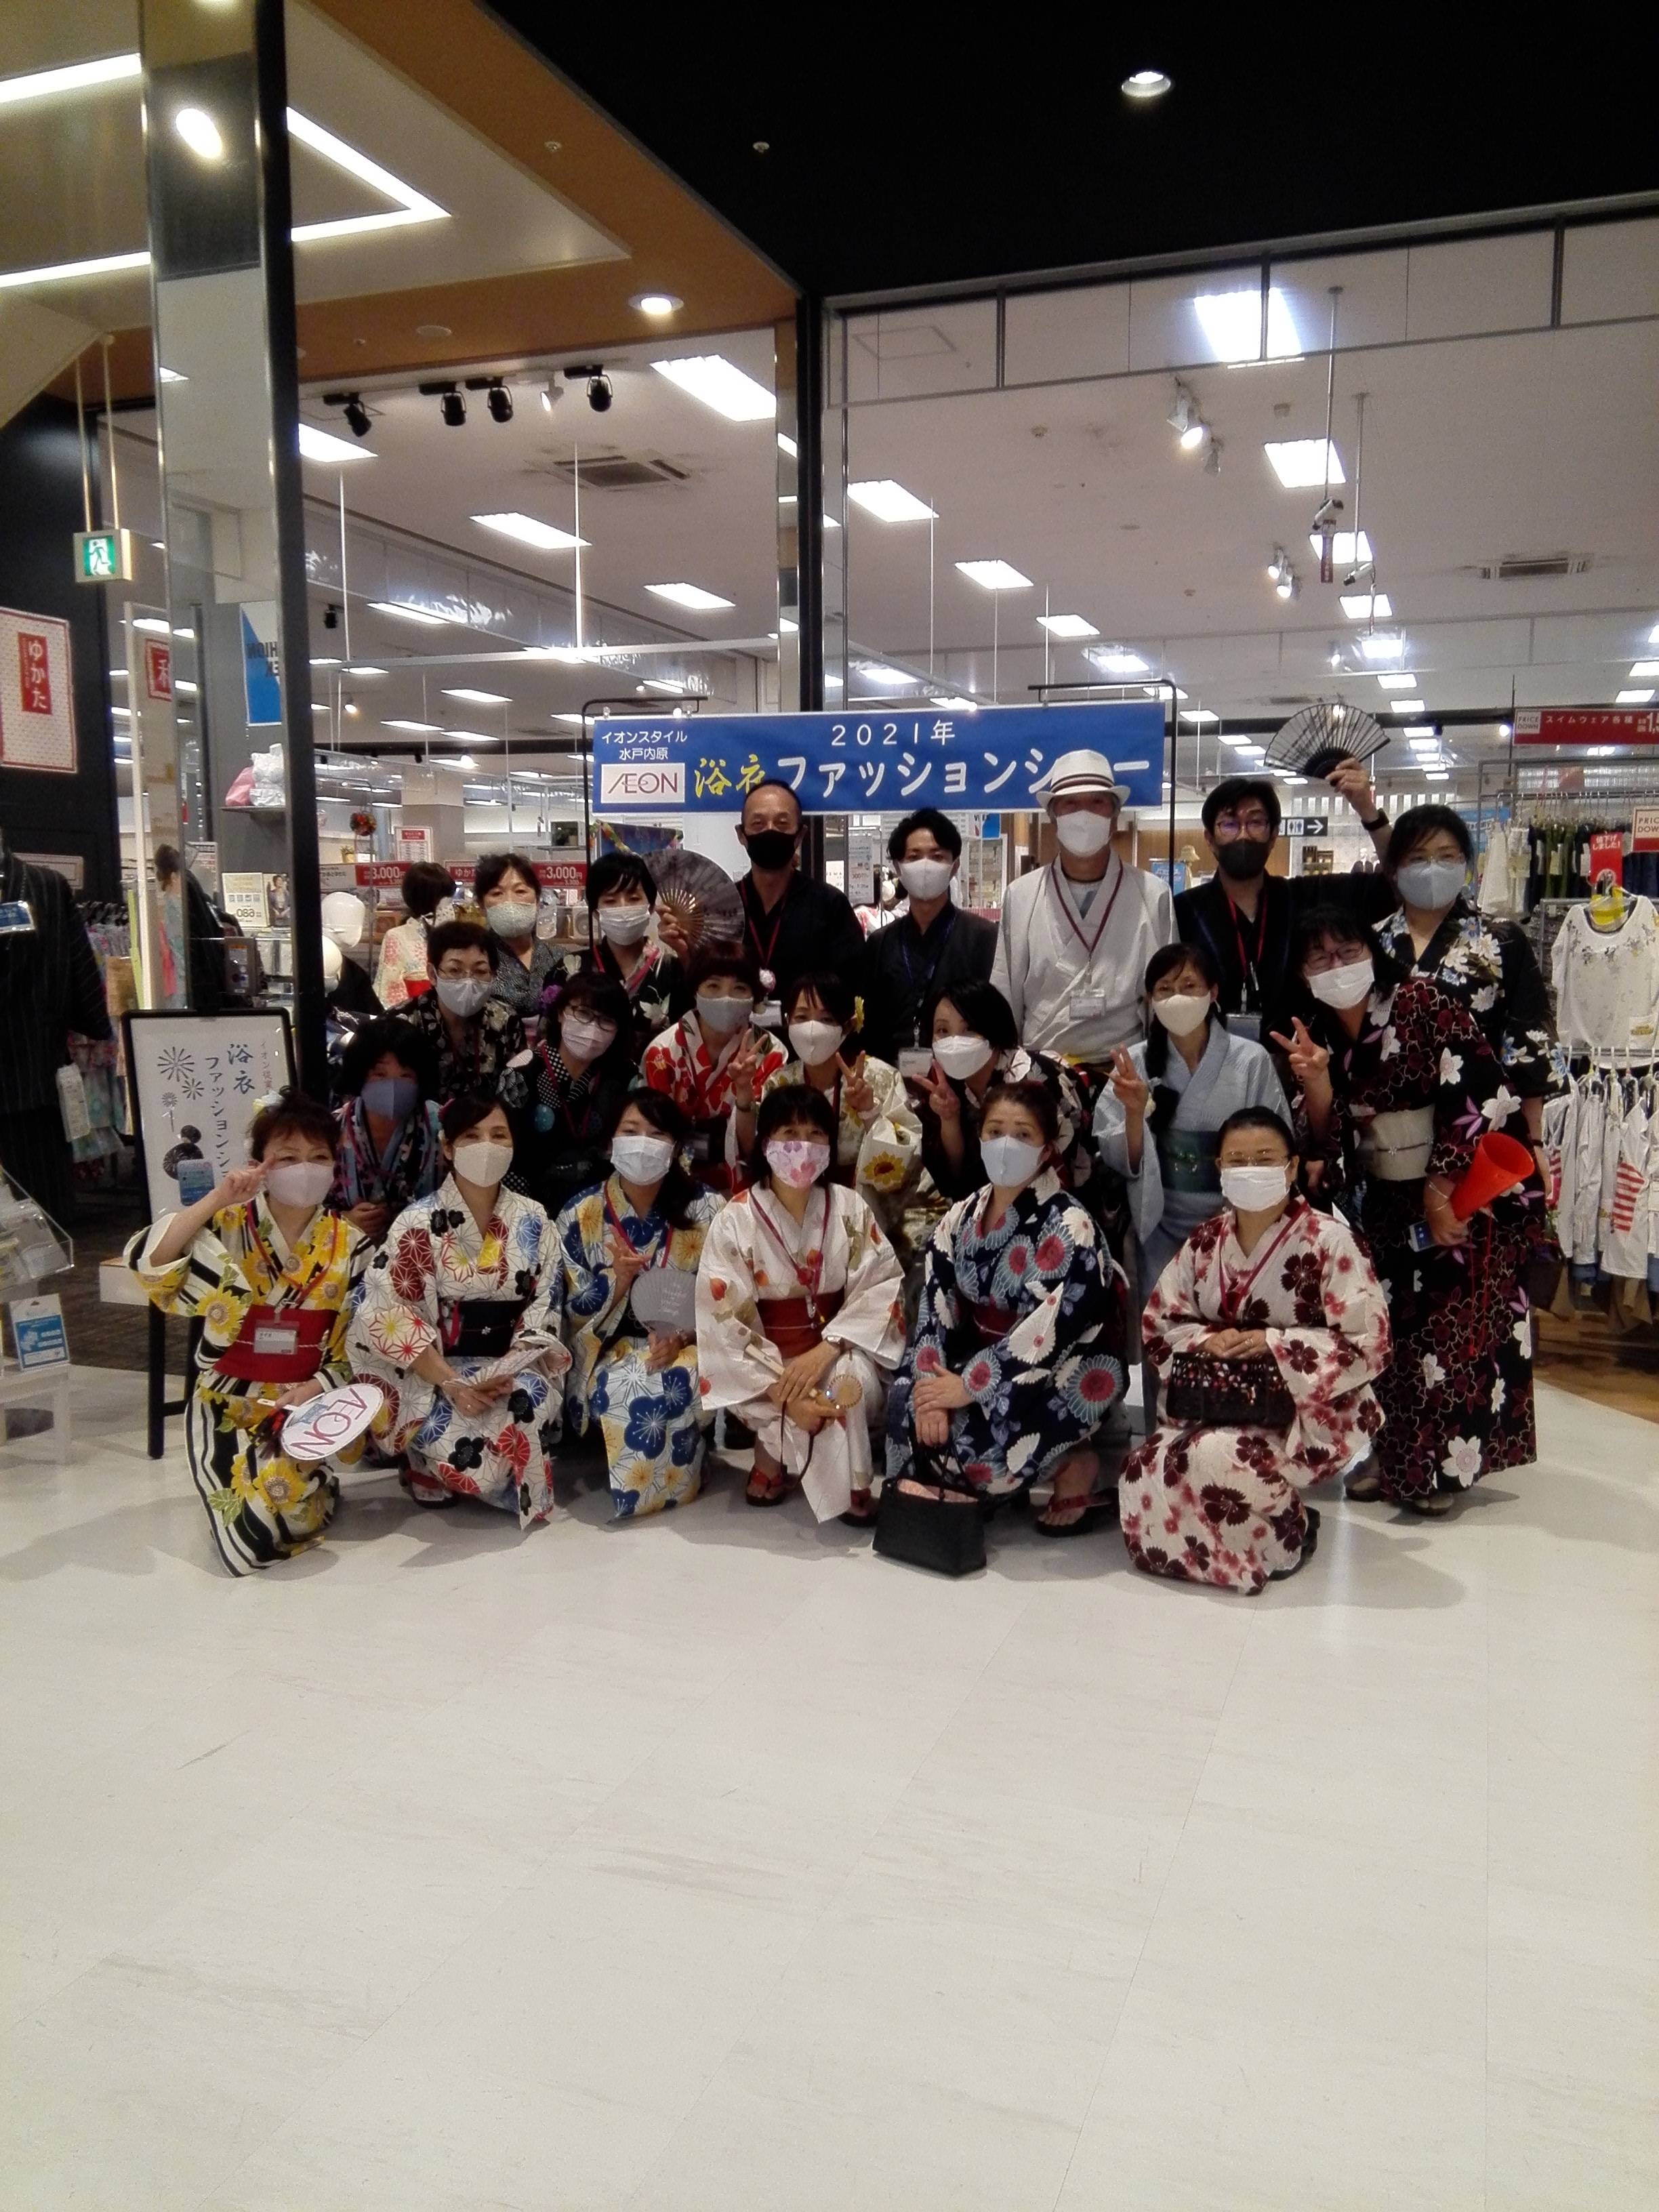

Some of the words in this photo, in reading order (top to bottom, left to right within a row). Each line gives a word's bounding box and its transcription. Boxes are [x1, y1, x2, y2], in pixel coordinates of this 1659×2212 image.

[28, 640, 47, 709] ゆかた
[1546, 715, 1633, 724] スイムウェア各種
[601, 731, 688, 744] イオンスタイル
[831, 719, 956, 746] 2021年
[619, 747, 668, 760] 水戸内原
[226, 1043, 255, 1095] 浴衣
